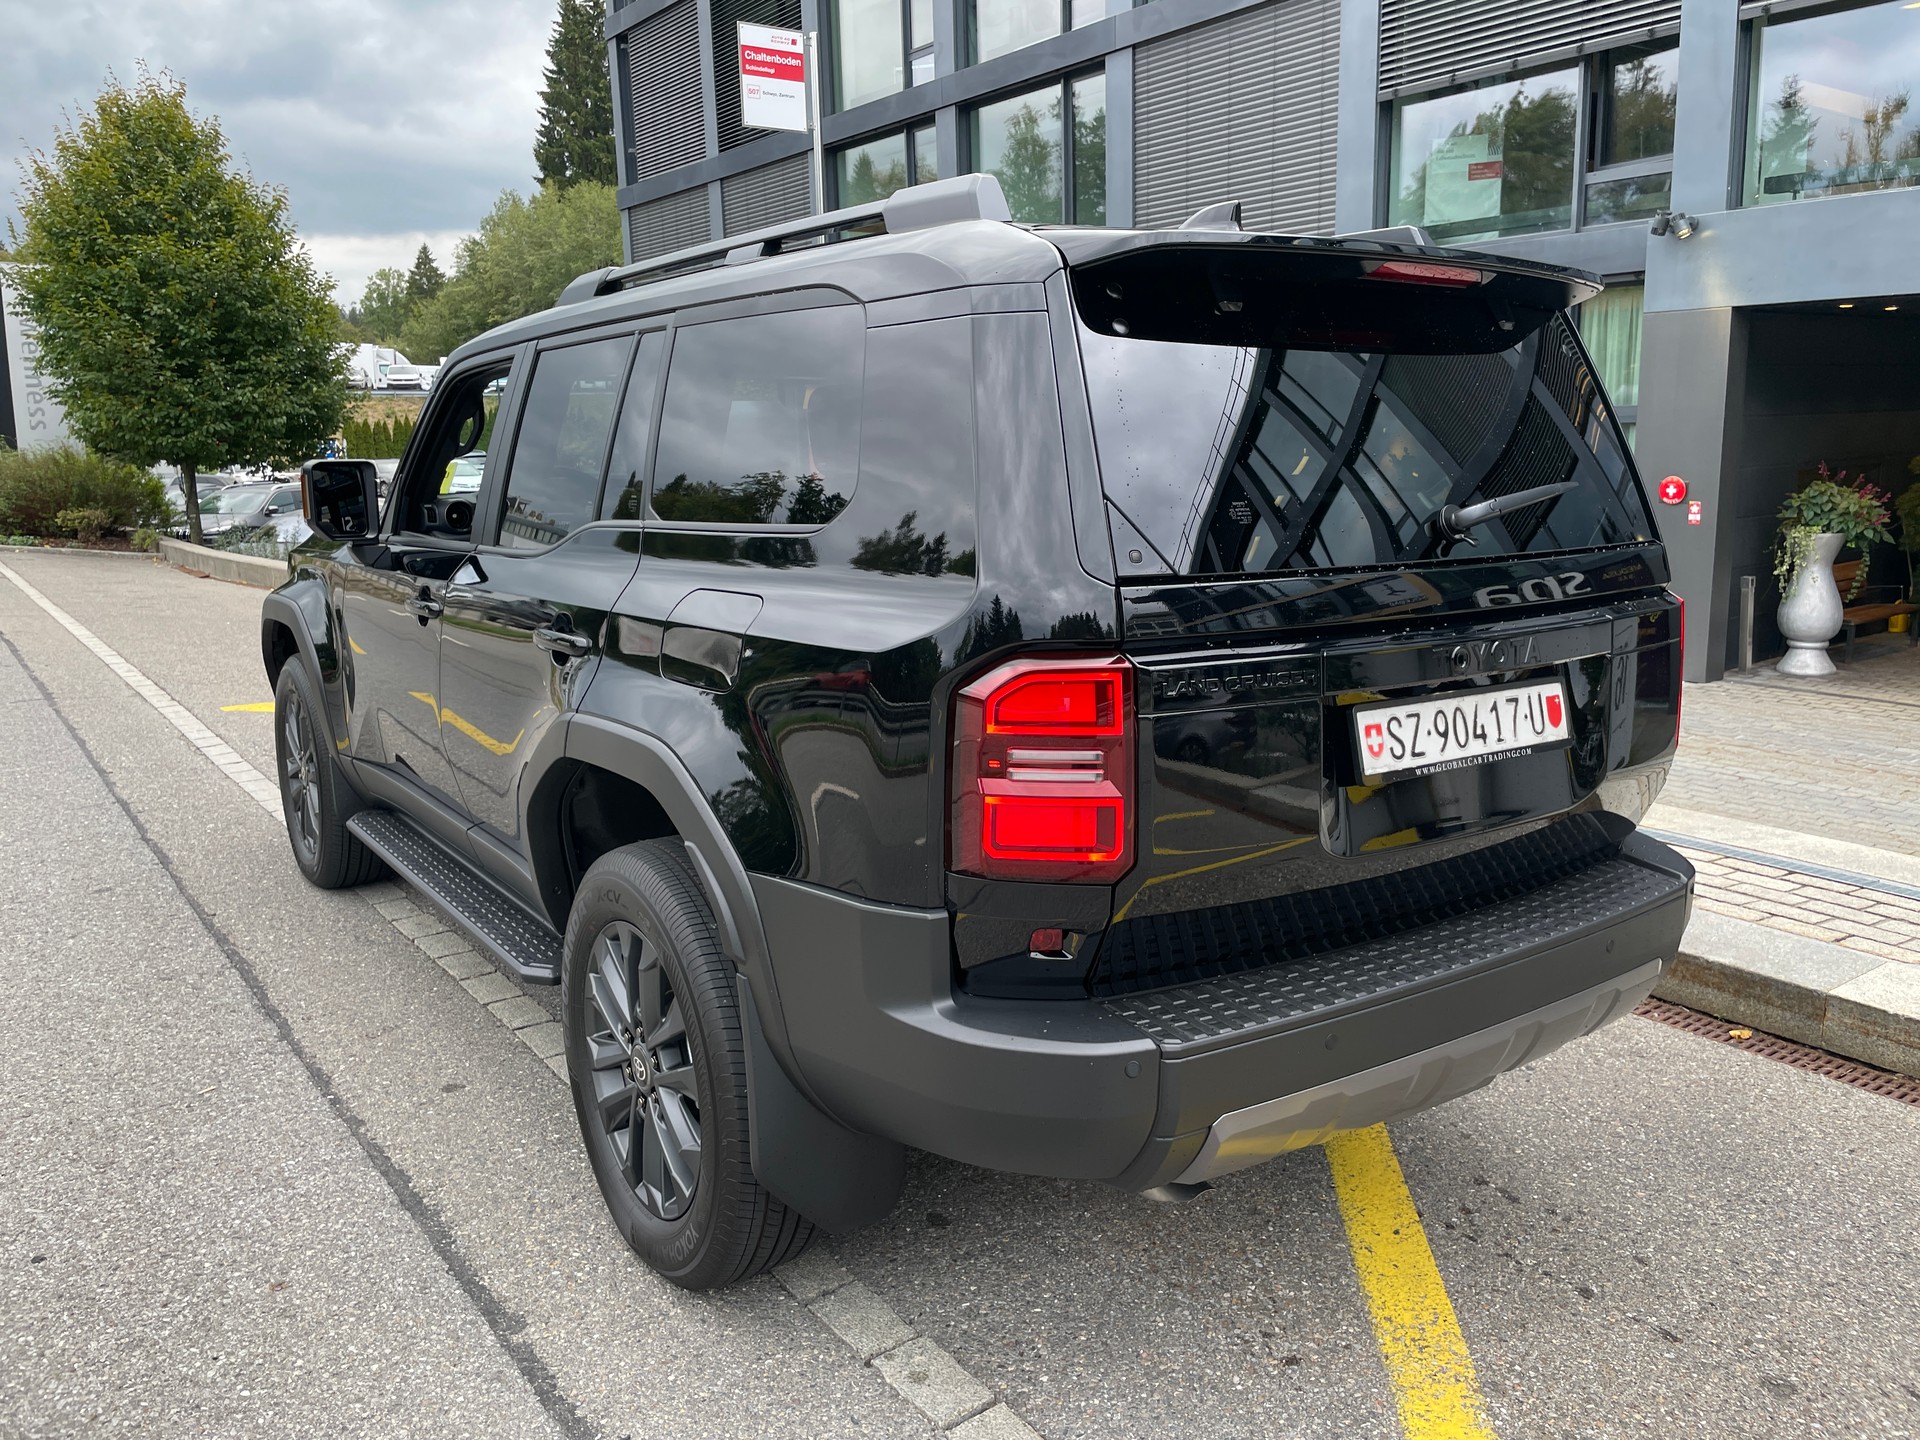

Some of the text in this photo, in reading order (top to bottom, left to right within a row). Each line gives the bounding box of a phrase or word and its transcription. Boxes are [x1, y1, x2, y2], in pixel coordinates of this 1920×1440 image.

[744, 50, 802, 67] Chaltenboden
[748, 87, 760, 95] 507
[1432, 636, 1542, 675] TOYOTA
[1162, 669, 1319, 698] LAND CRUISER
